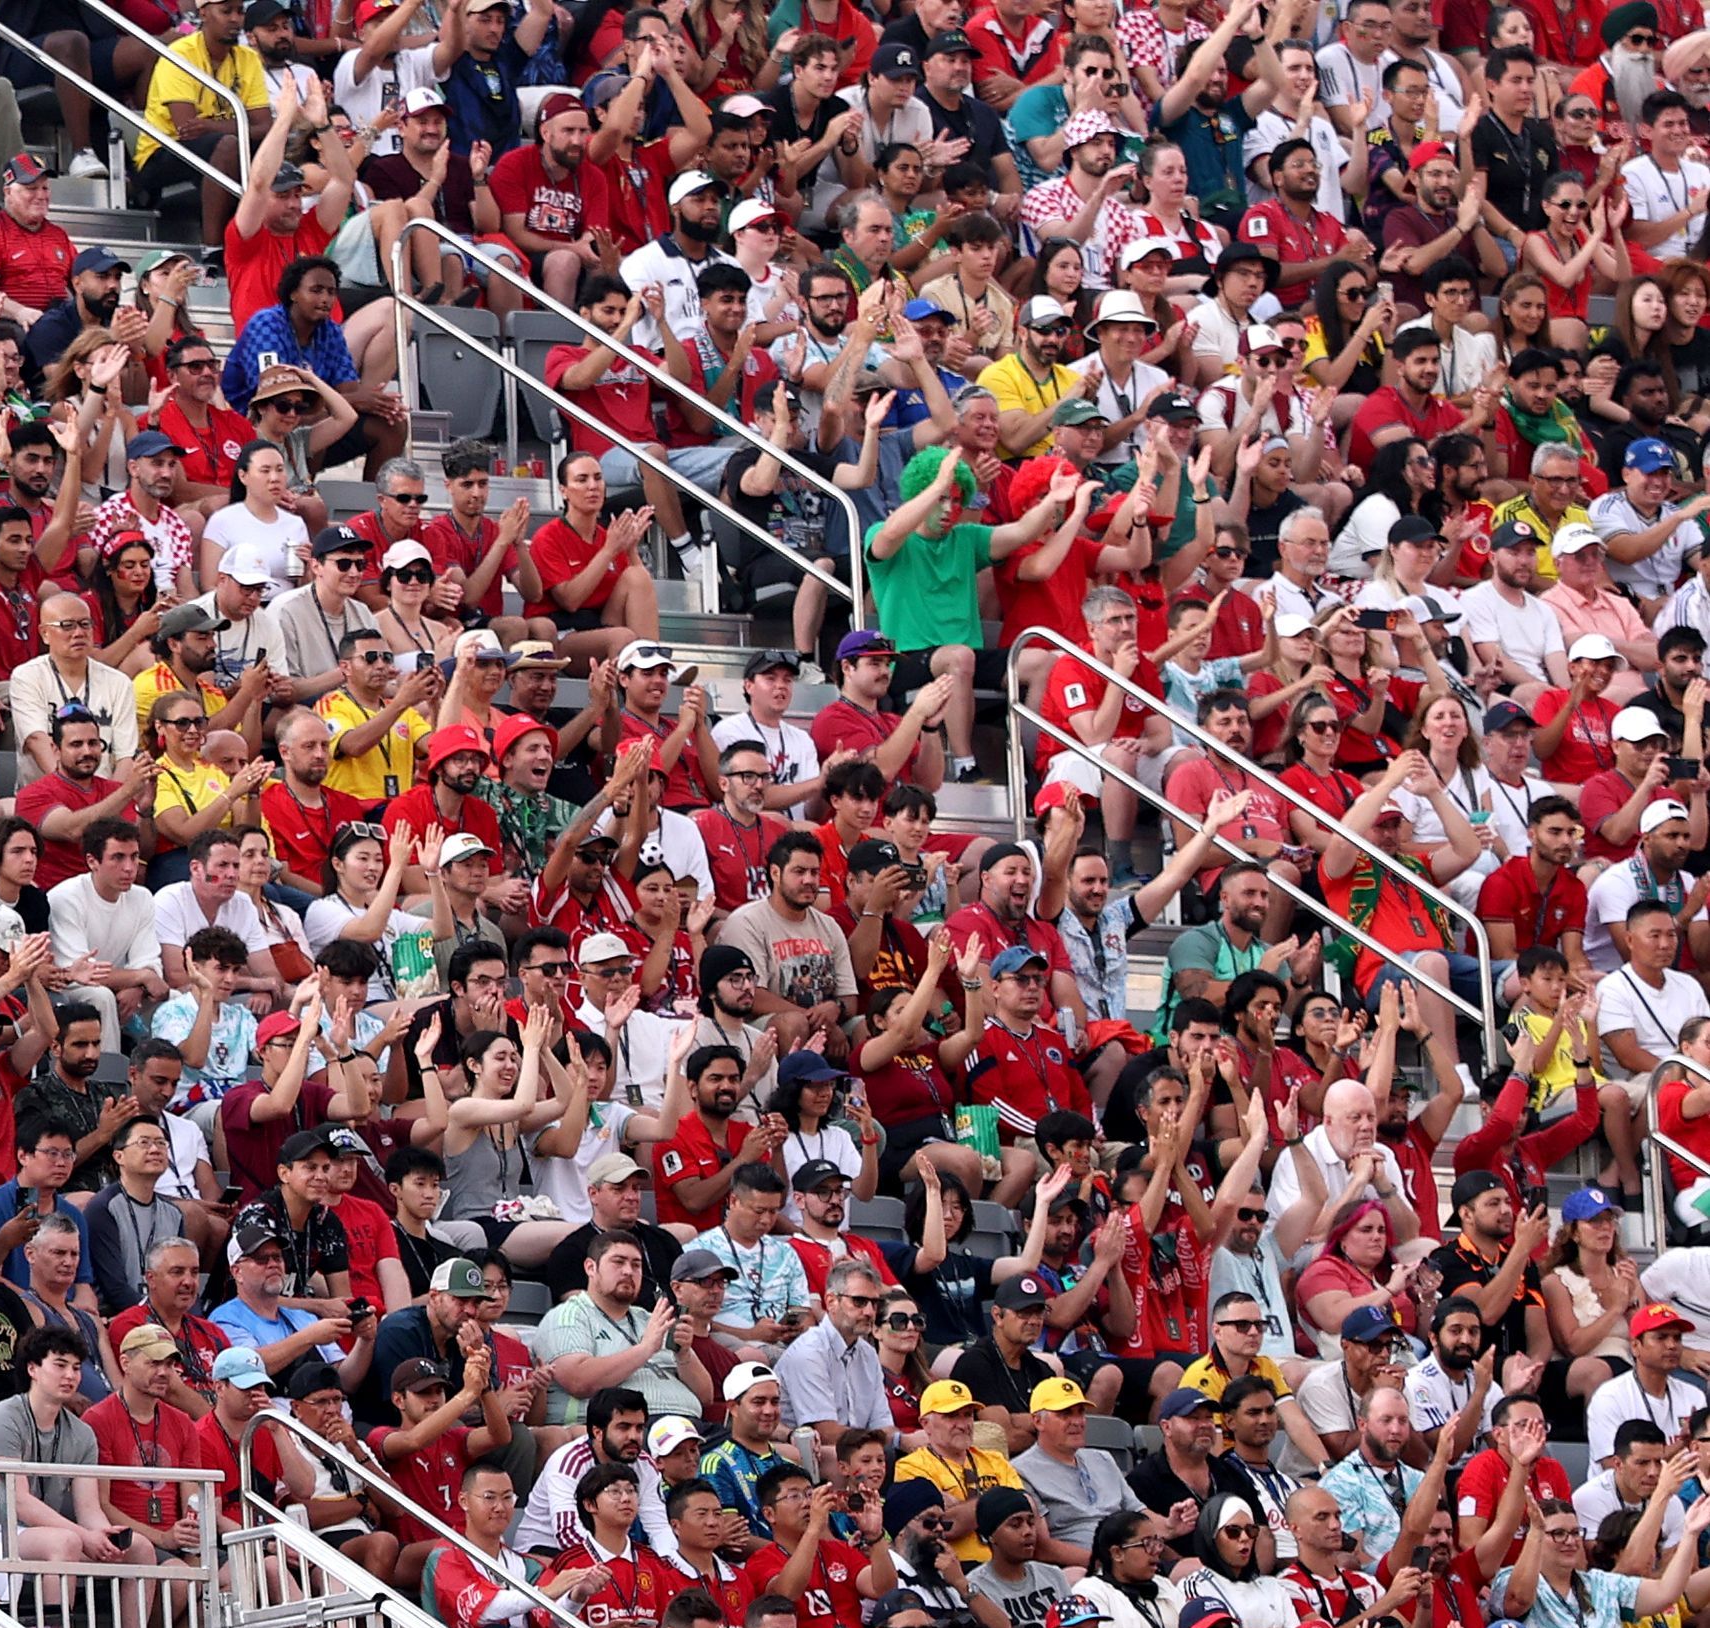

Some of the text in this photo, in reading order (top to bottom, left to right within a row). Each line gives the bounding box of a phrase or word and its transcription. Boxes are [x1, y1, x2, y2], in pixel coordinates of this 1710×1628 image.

[772, 937, 832, 961] FUTEBOL
[438, 1484, 452, 1512] 7
[1002, 1586, 1057, 1625] JUST
